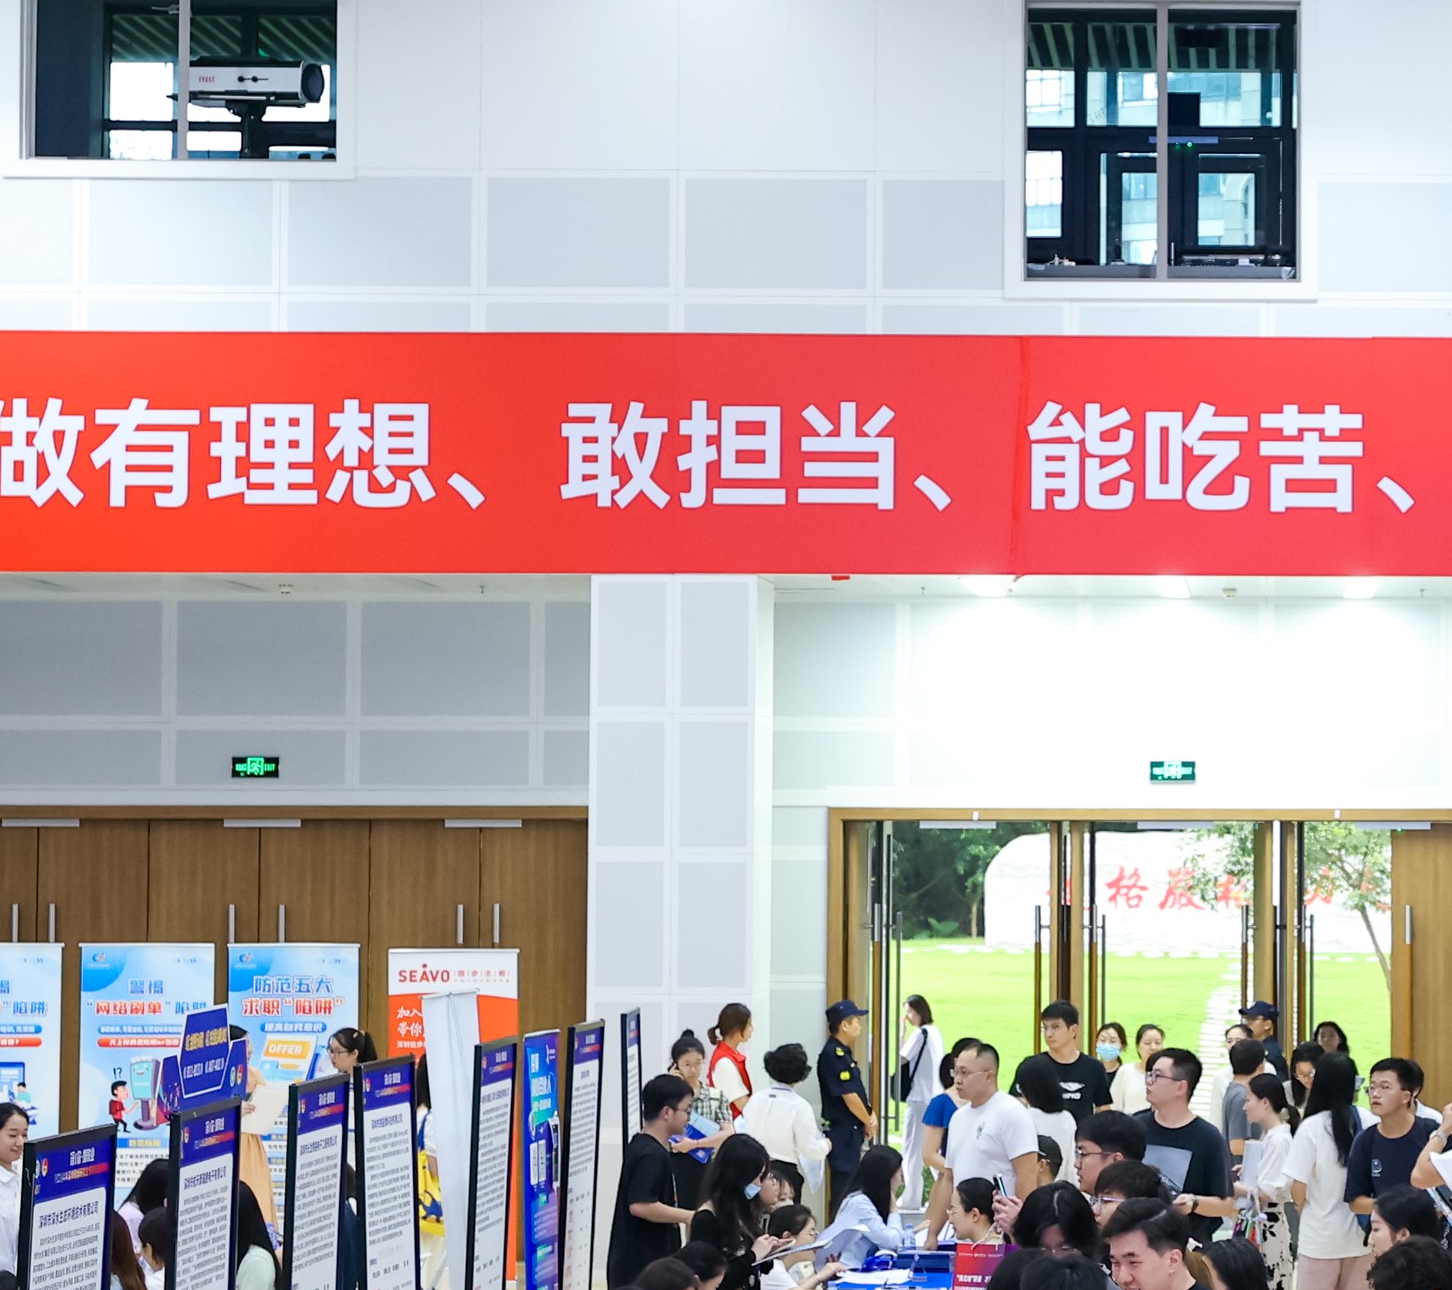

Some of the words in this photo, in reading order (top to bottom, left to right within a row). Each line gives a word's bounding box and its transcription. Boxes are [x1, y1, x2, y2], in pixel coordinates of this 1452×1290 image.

[398, 964, 450, 982] SEAVO
[253, 975, 333, 994] 防范五大
[268, 1042, 303, 1055] OFFER
